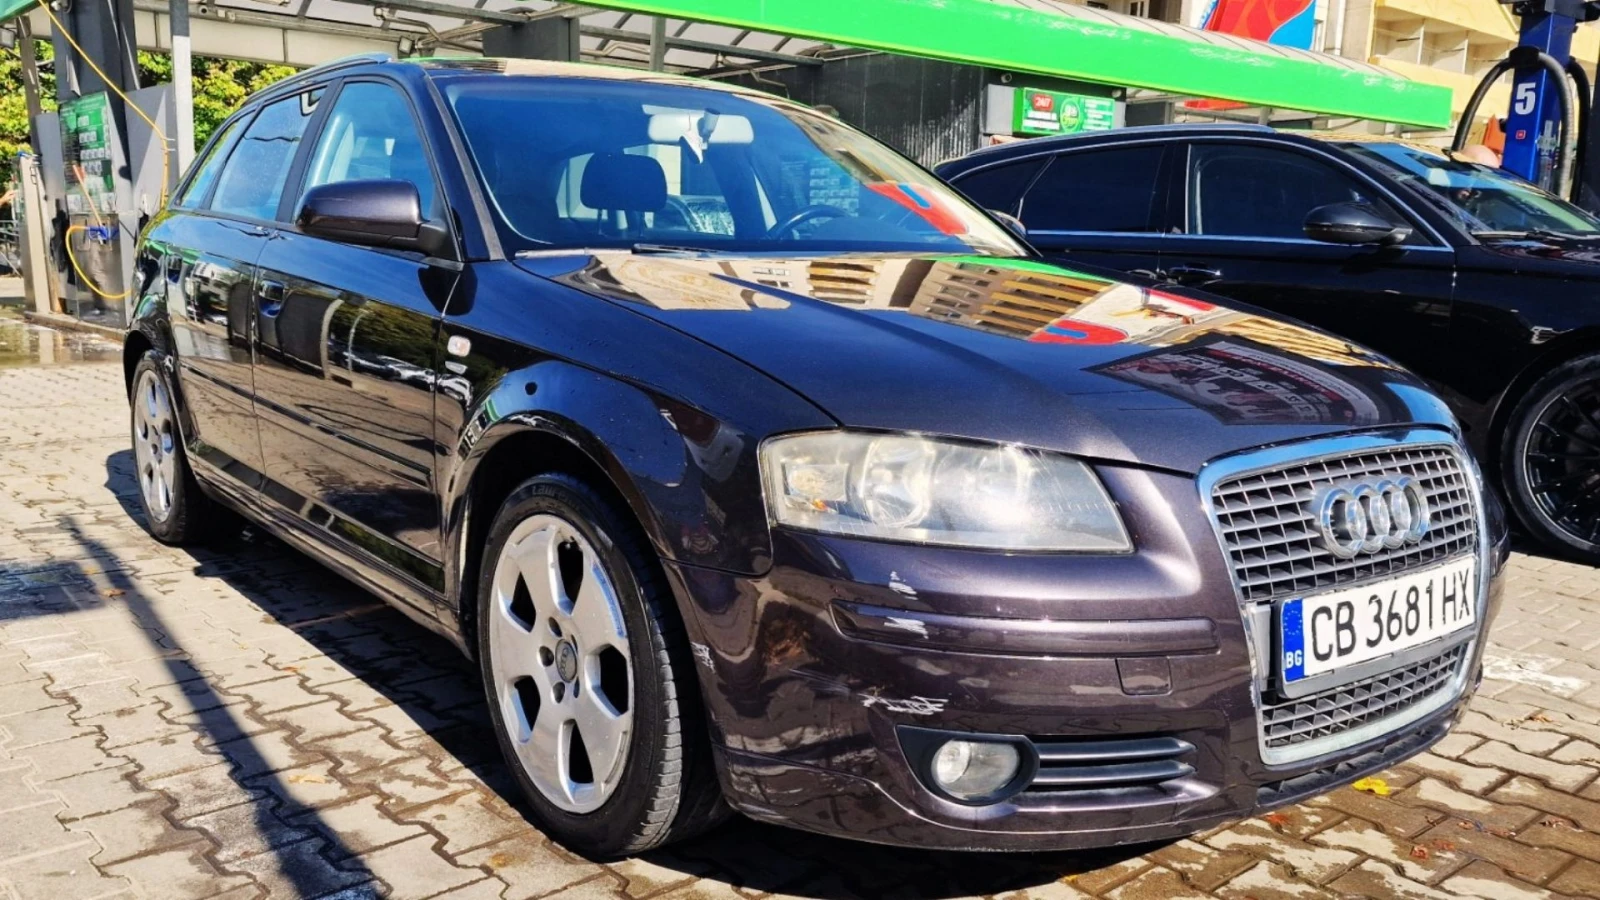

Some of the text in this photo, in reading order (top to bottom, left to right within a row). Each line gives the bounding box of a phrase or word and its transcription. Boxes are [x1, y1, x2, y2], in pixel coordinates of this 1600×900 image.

[1514, 82, 1536, 115] 5
[1311, 568, 1470, 662] CB 3681 HX
[1286, 650, 1303, 668] BG
